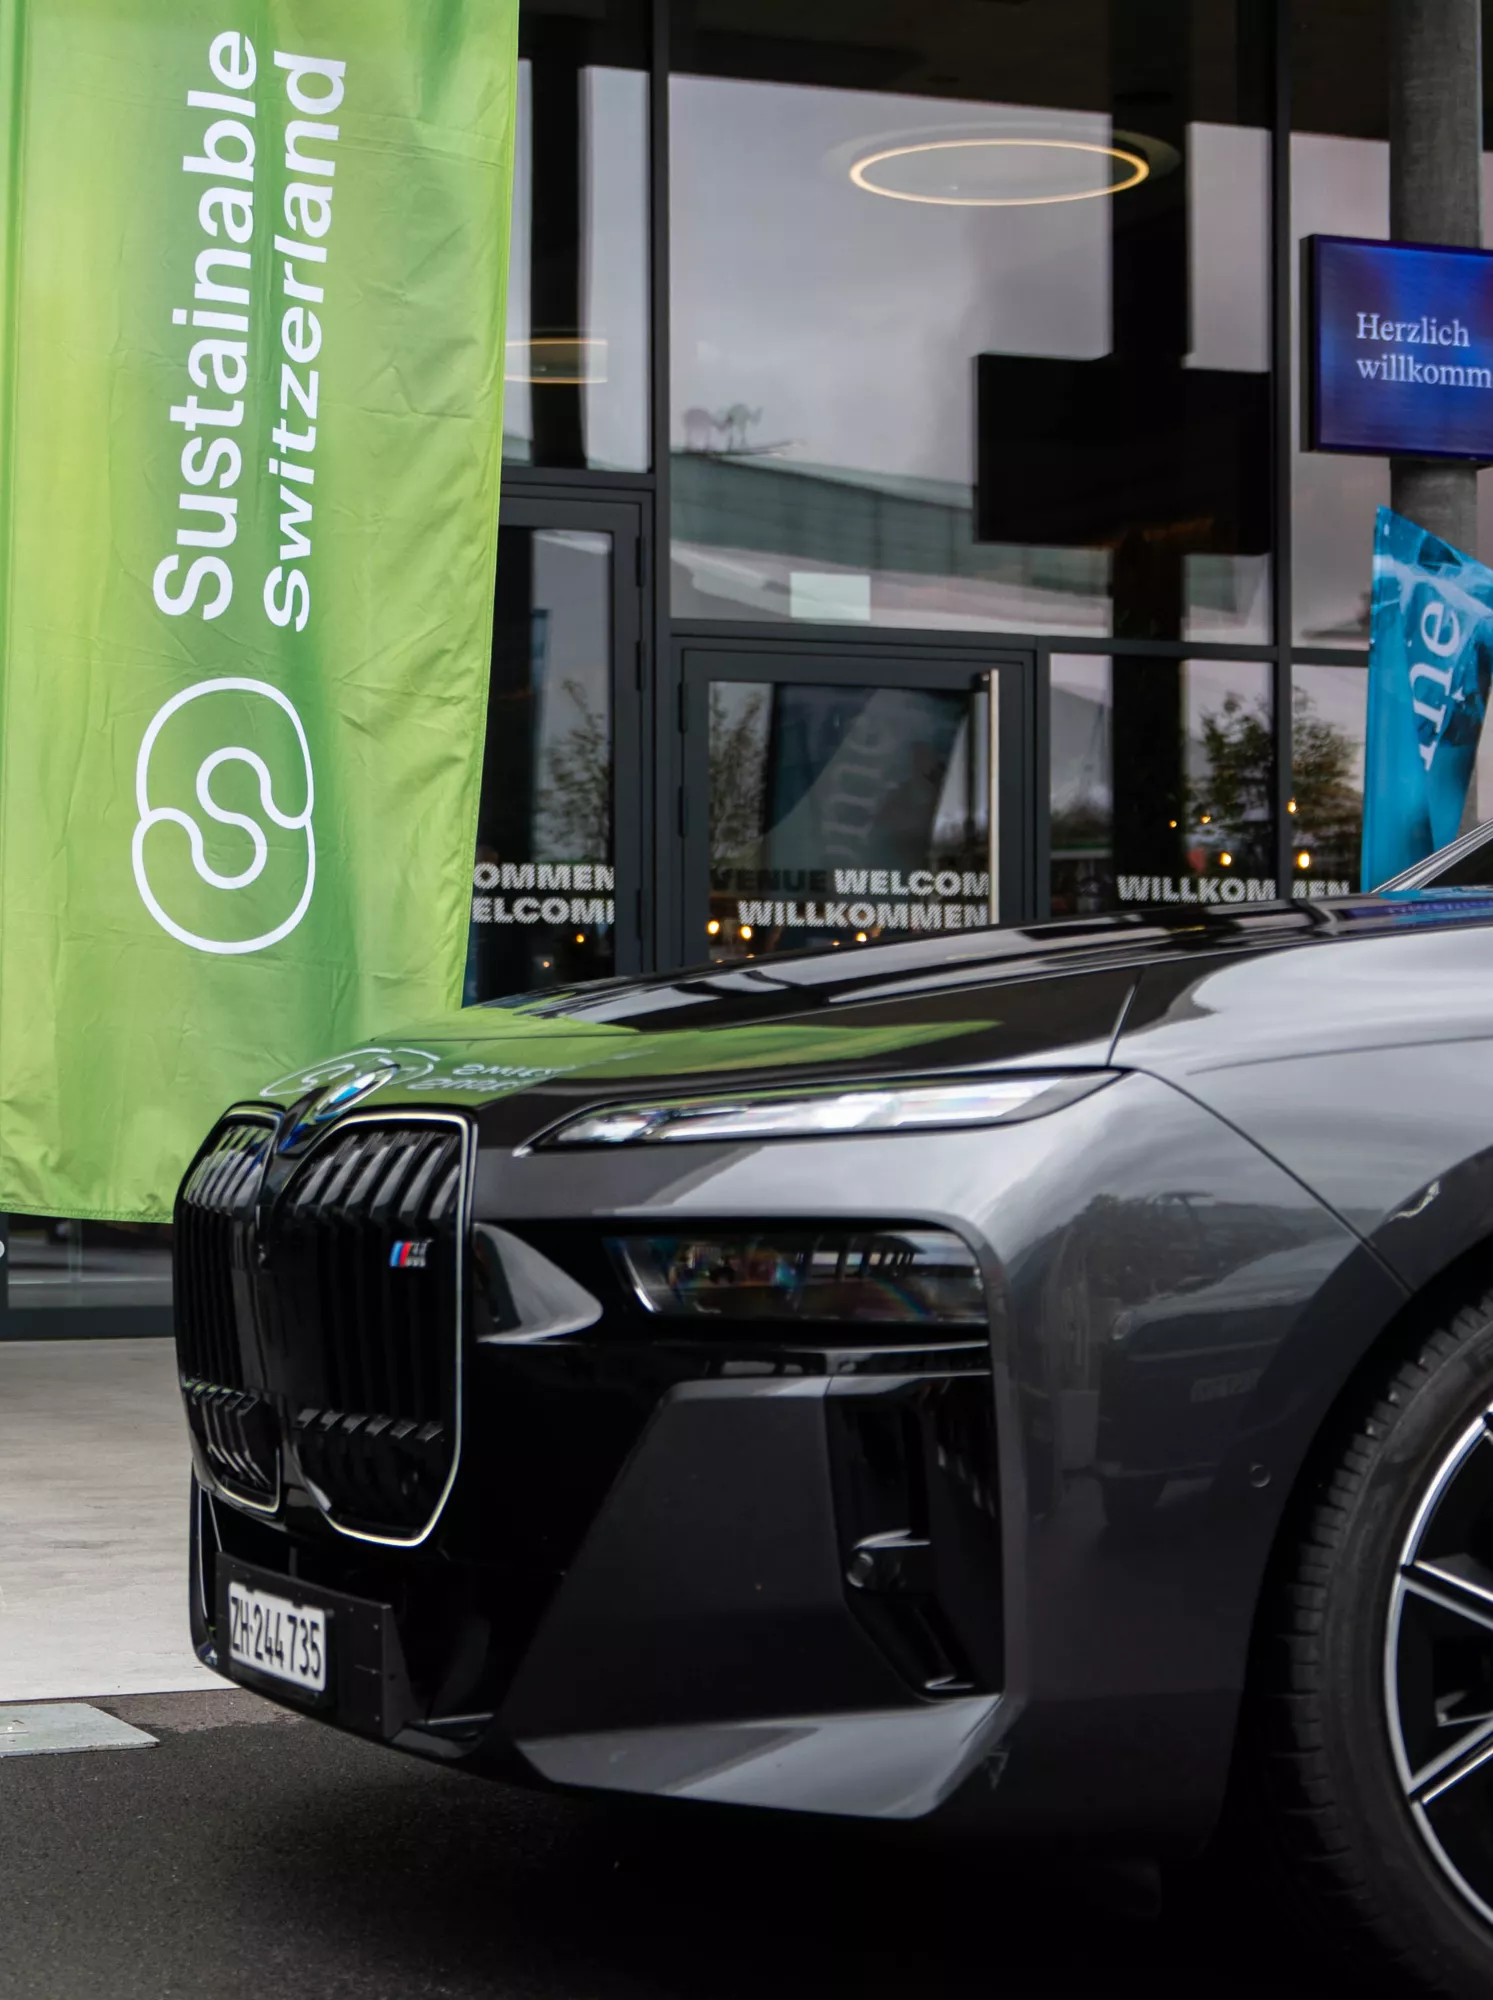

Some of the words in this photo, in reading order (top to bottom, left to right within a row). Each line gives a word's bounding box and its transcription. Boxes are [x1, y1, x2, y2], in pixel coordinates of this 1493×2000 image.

[153, 31, 257, 620] Sustainable
[263, 51, 347, 632] Switzerland
[1356, 311, 1470, 347] Herzlich
[1355, 353, 1493, 389] willkomm
[738, 900, 989, 930] WILLKOMMEN
